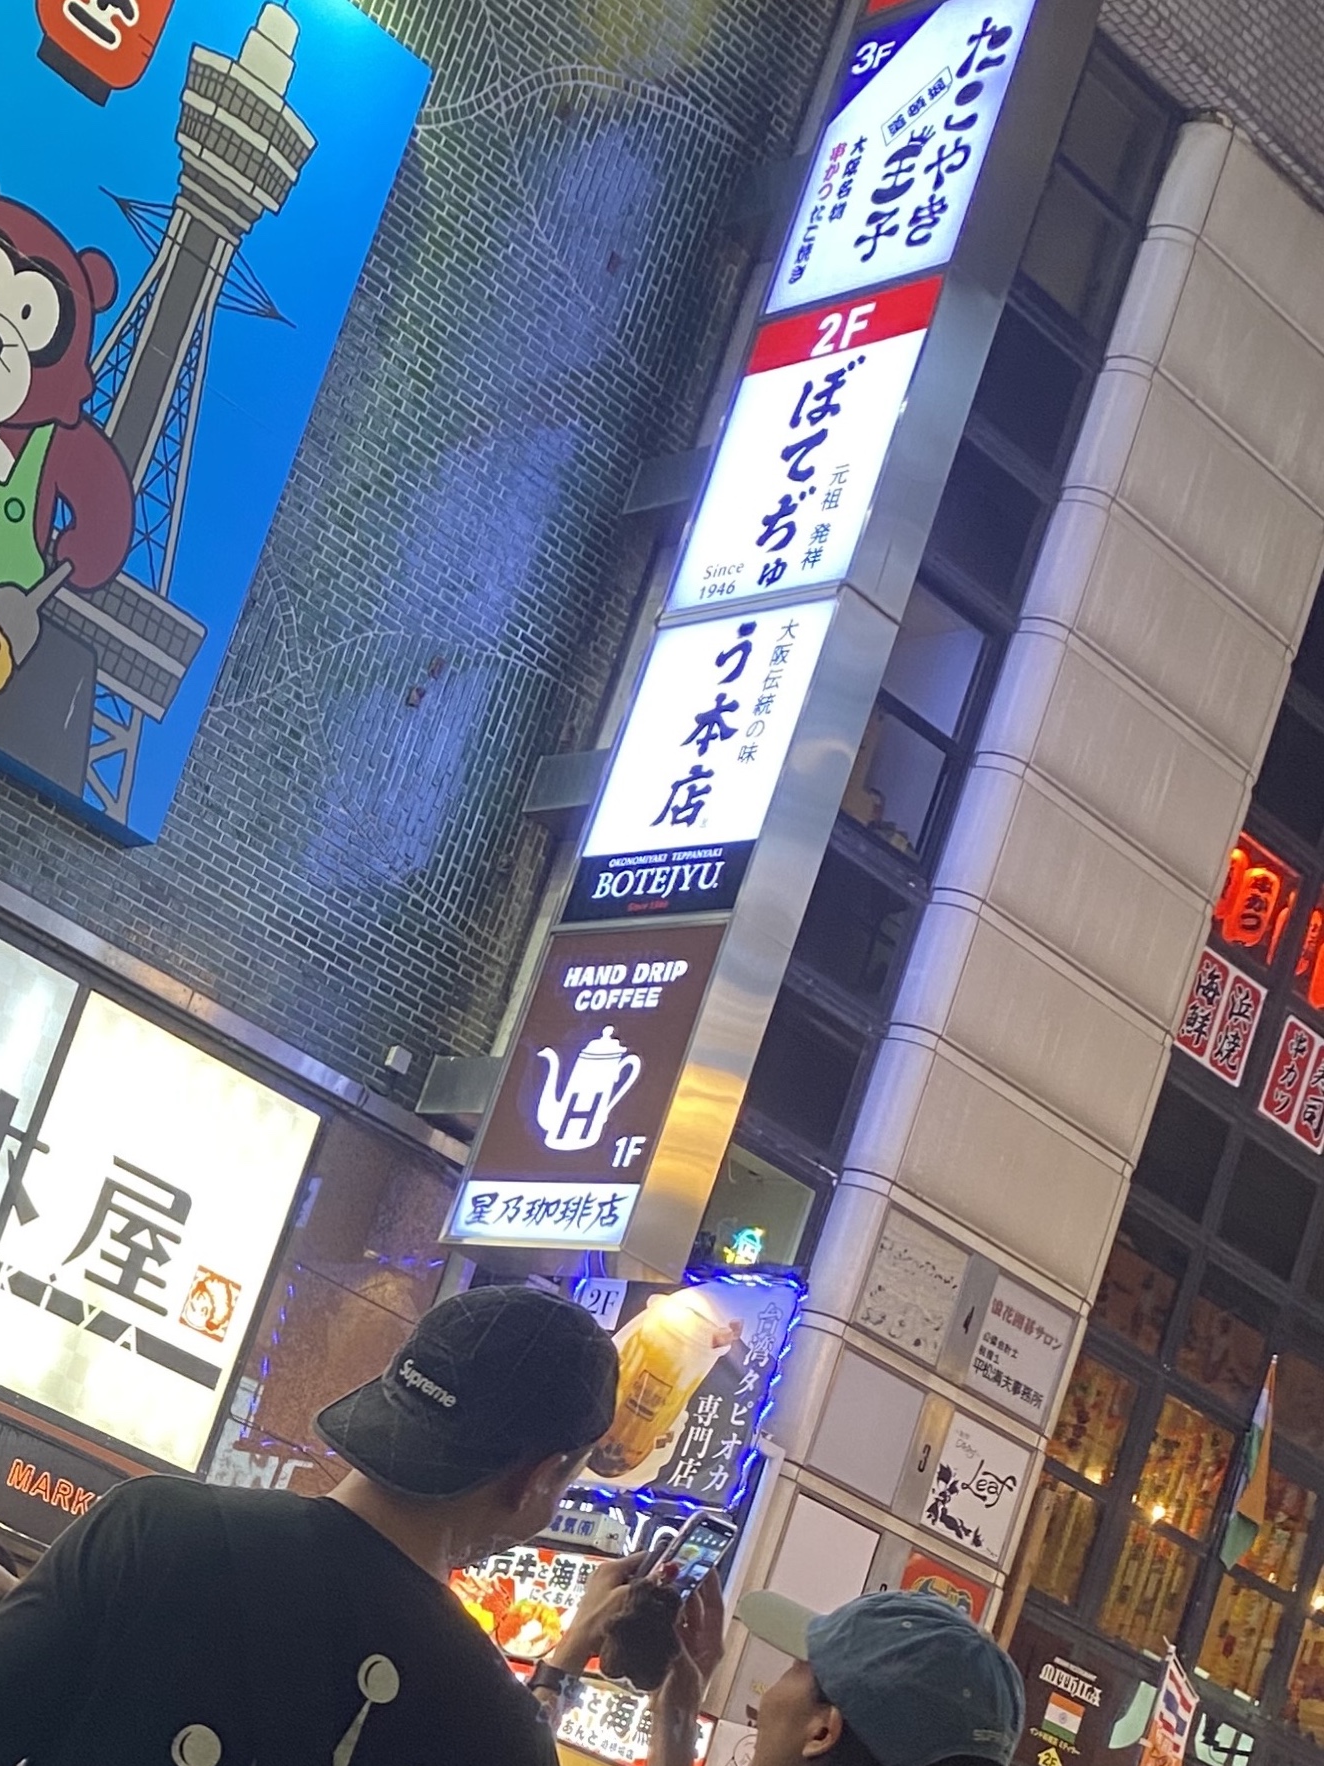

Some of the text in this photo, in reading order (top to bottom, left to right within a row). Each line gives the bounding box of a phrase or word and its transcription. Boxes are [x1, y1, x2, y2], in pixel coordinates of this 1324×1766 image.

[850, 41, 896, 75] 3F
[904, 16, 1013, 247] たこやき
[827, 135, 868, 224] 大阪名物
[809, 302, 878, 357] 2F
[799, 462, 850, 571] 元祖 発祥
[699, 580, 737, 600] 1946
[703, 561, 745, 581] Since
[736, 619, 801, 765] 大阪伝統の味
[608, 848, 724, 868] OKONOMIYAKI TEPPANYAKI
[562, 959, 690, 990] HAND DRIP
[573, 985, 663, 1013] COFFEE
[1178, 960, 1222, 1047] 海鮮
[1272, 1028, 1308, 1115] 串カツ
[610, 1136, 648, 1169] 1F
[464, 1190, 625, 1229] 星乃珈琲店
[587, 1288, 620, 1316] 2F
[398, 1358, 457, 1408] Supreme
[701, 1301, 784, 1492] 台湾タピオカ
[666, 1394, 724, 1490] 専門店
[6, 1457, 104, 1517] MARK
[960, 1459, 1018, 1509] Leaf
